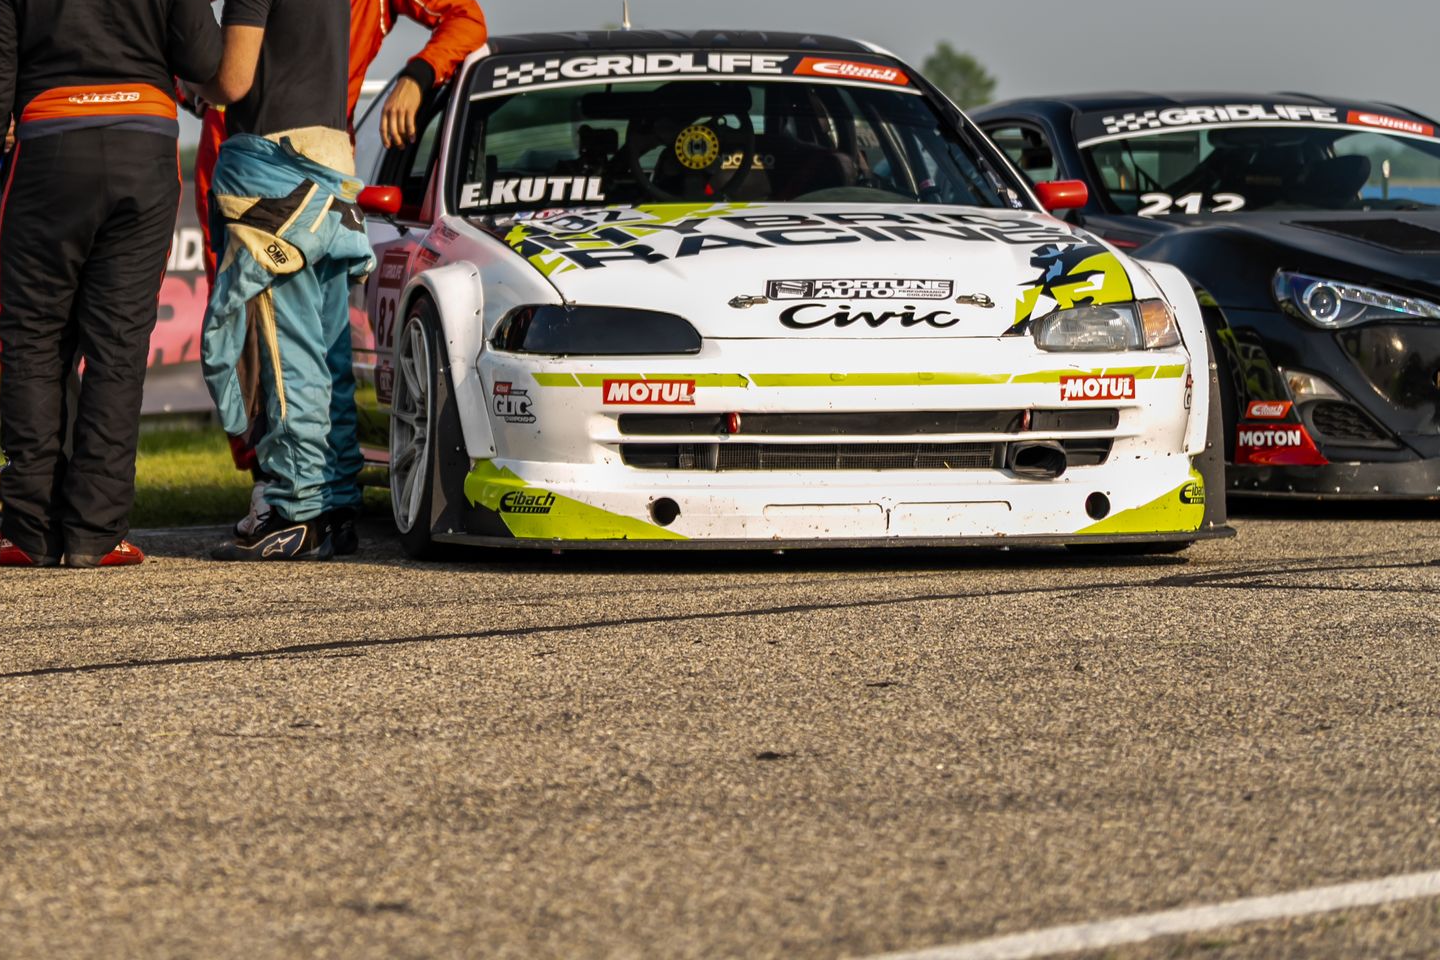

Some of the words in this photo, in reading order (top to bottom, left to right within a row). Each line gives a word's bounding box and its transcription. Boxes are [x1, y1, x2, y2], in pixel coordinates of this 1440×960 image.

[560, 55, 789, 78] GRIDLIFE
[1160, 104, 1338, 125] GRIDLIFE
[460, 176, 606, 208] E.KUTIL
[1138, 192, 1246, 219] 212
[266, 242, 288, 266] OMP
[560, 226, 1087, 270] RACING
[813, 280, 951, 289] FORTUNE
[813, 288, 893, 299] AUTO
[779, 303, 961, 331] Civic
[607, 383, 696, 402] MOTUL
[1067, 377, 1134, 398] MOTUL
[1239, 430, 1301, 446] MOTON
[498, 490, 556, 514] Eibach
